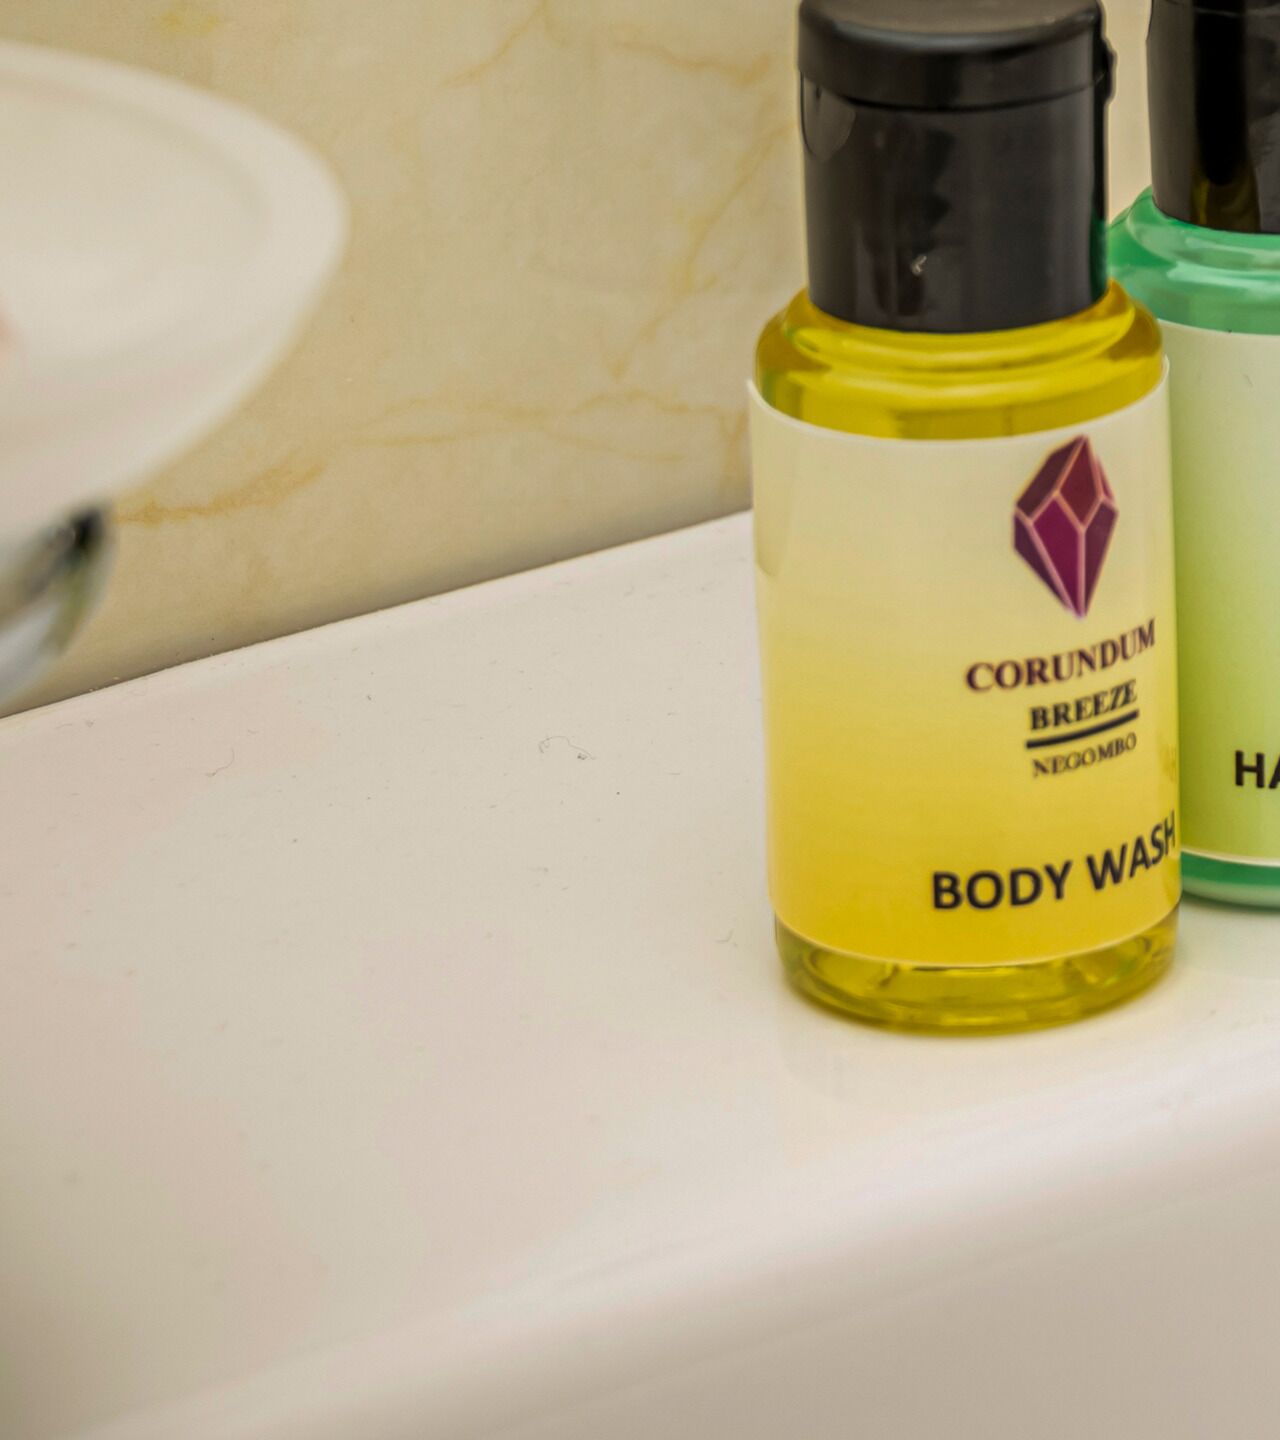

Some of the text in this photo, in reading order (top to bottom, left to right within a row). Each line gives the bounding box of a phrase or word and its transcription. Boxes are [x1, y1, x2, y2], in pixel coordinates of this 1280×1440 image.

[964, 617, 1156, 694] CORUNDUM
[1028, 678, 1138, 733] BREEZE
[1030, 731, 1138, 780] NEGOMBO
[931, 809, 1176, 912] BODY WASH
